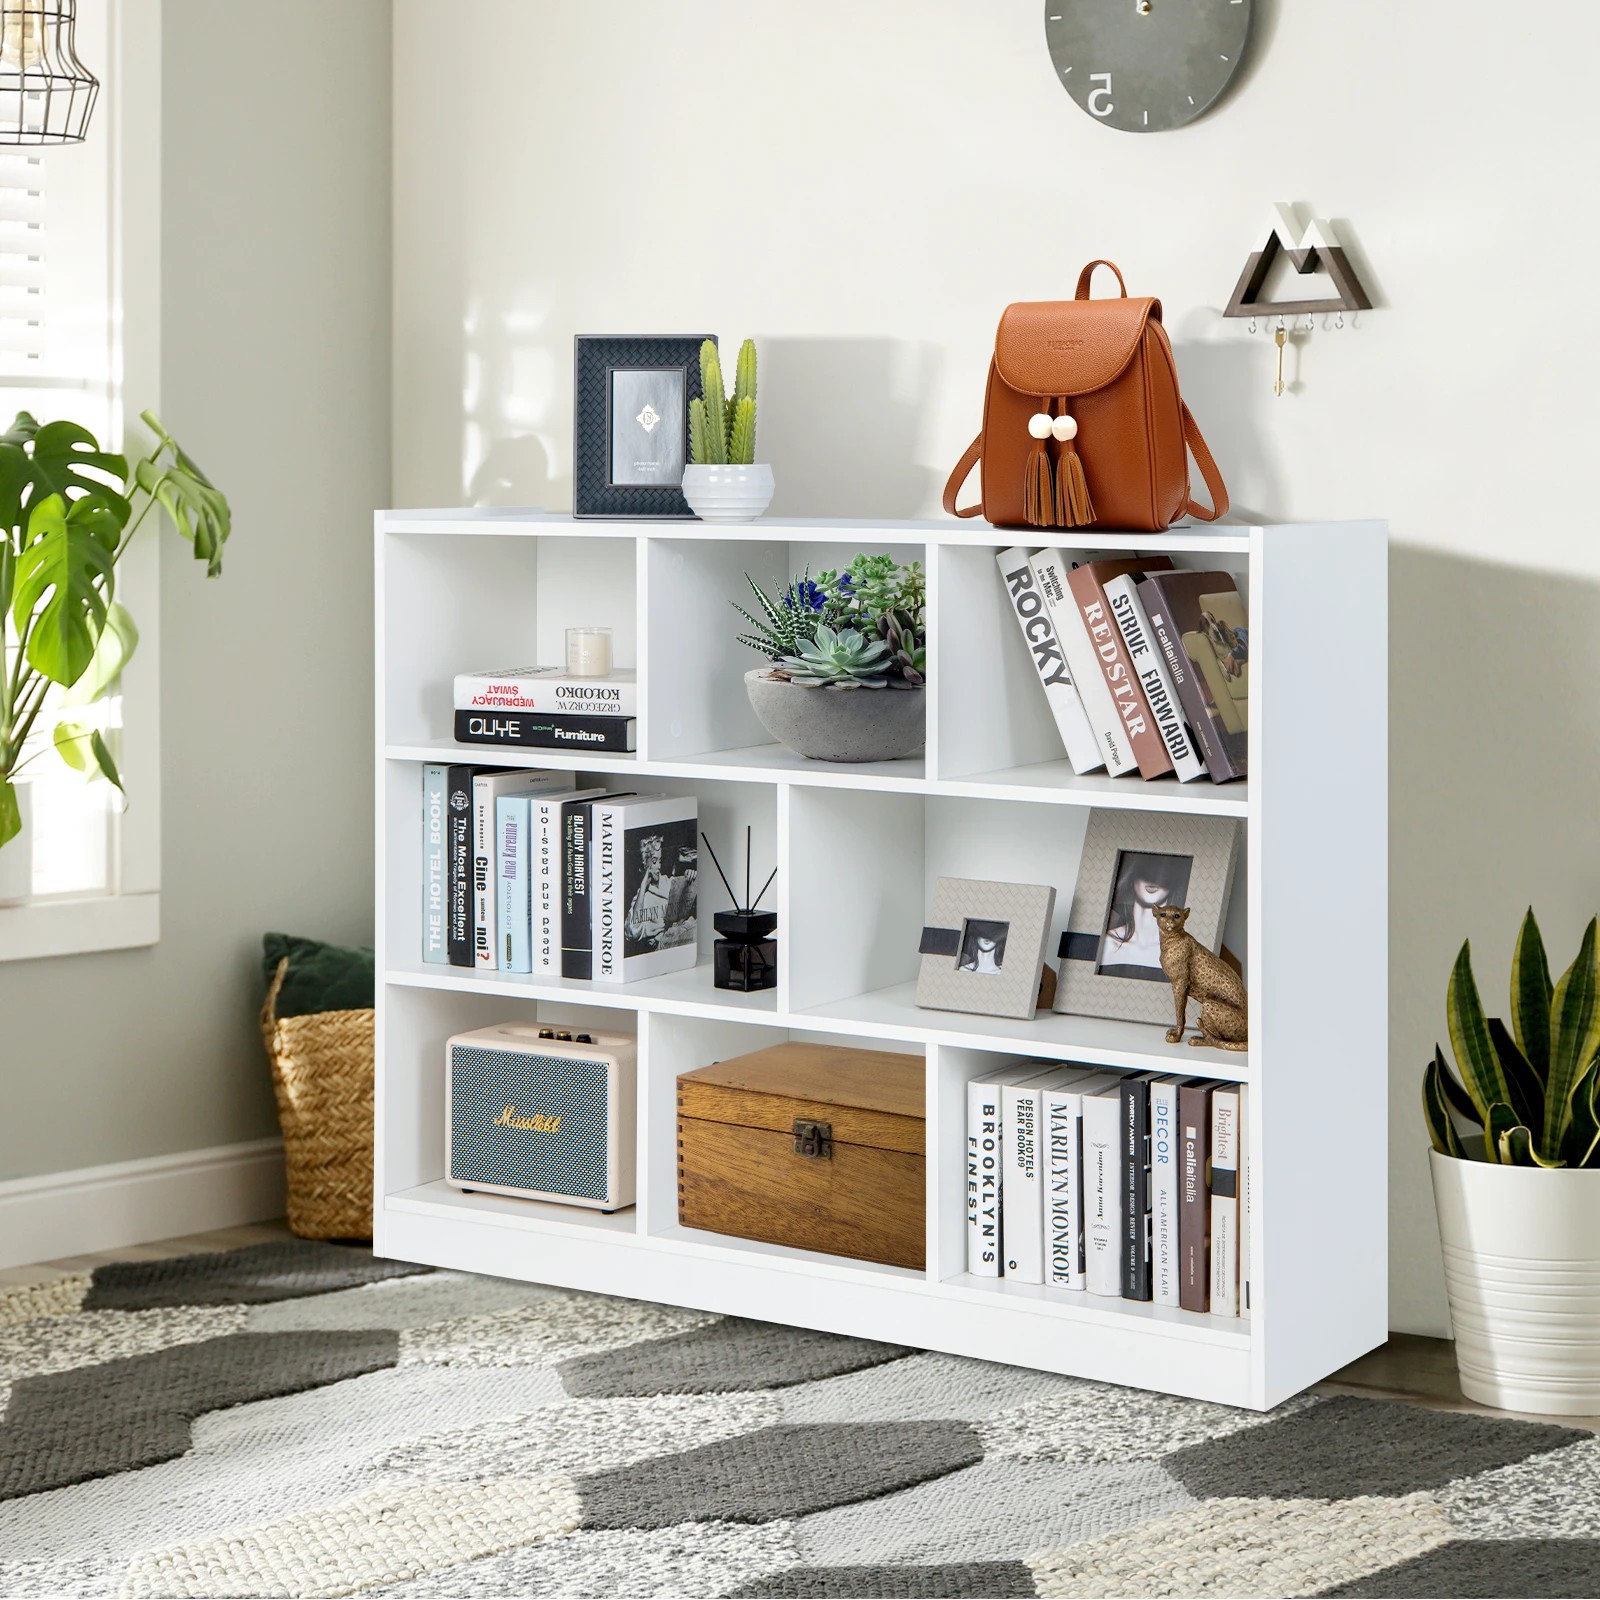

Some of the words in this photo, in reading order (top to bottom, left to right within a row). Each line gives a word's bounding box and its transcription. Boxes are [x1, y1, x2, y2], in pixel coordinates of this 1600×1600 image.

[1043, 582, 1053, 598] Mac
[1045, 565, 1064, 601] Switching
[1005, 565, 1072, 689] ROCKY
[1158, 628, 1184, 684] caliaitalia
[487, 685, 519, 697] ŚWIAT
[555, 686, 620, 700] KOŁODKO
[1112, 593, 1149, 659] STRIVE
[1141, 668, 1190, 761] FORWARD
[472, 696, 535, 708] WĘDRUJĄCY
[568, 701, 621, 713] GRZEGORZ
[554, 728, 605, 742] Furniture
[1104, 730, 1115, 749] David
[430, 792, 441, 844] BOOK
[457, 817, 467, 841] The
[574, 815, 584, 851] BLOODY
[502, 823, 518, 859] Karenina
[540, 806, 549, 875] passion
[601, 813, 613, 894] MARILYN
[430, 849, 441, 910] HOTEL
[457, 846, 467, 877] Most
[475, 856, 489, 892] Cine
[502, 860, 517, 880] Anna
[574, 853, 585, 896] HARVEST
[457, 881, 467, 942] Excellent
[541, 882, 549, 910] and
[429, 913, 441, 952] THE
[541, 917, 550, 965] speed
[601, 899, 613, 975] MONROE
[1016, 1099, 1025, 1126] YEAR
[1025, 1099, 1034, 1138] DESIGN
[1050, 1103, 1068, 1193] MARILYN
[1156, 1105, 1169, 1164] DECOR
[1215, 1108, 1232, 1159] Brightest
[968, 1137, 977, 1226] FINEST
[982, 1104, 995, 1263] BROOKLYN'S
[1186, 1141, 1196, 1203] caliaitalia
[1051, 1197, 1069, 1284] MONROE
[1160, 1189, 1168, 1264] ALL-AMERICAN
[1161, 1266, 1169, 1296] FLAIR
